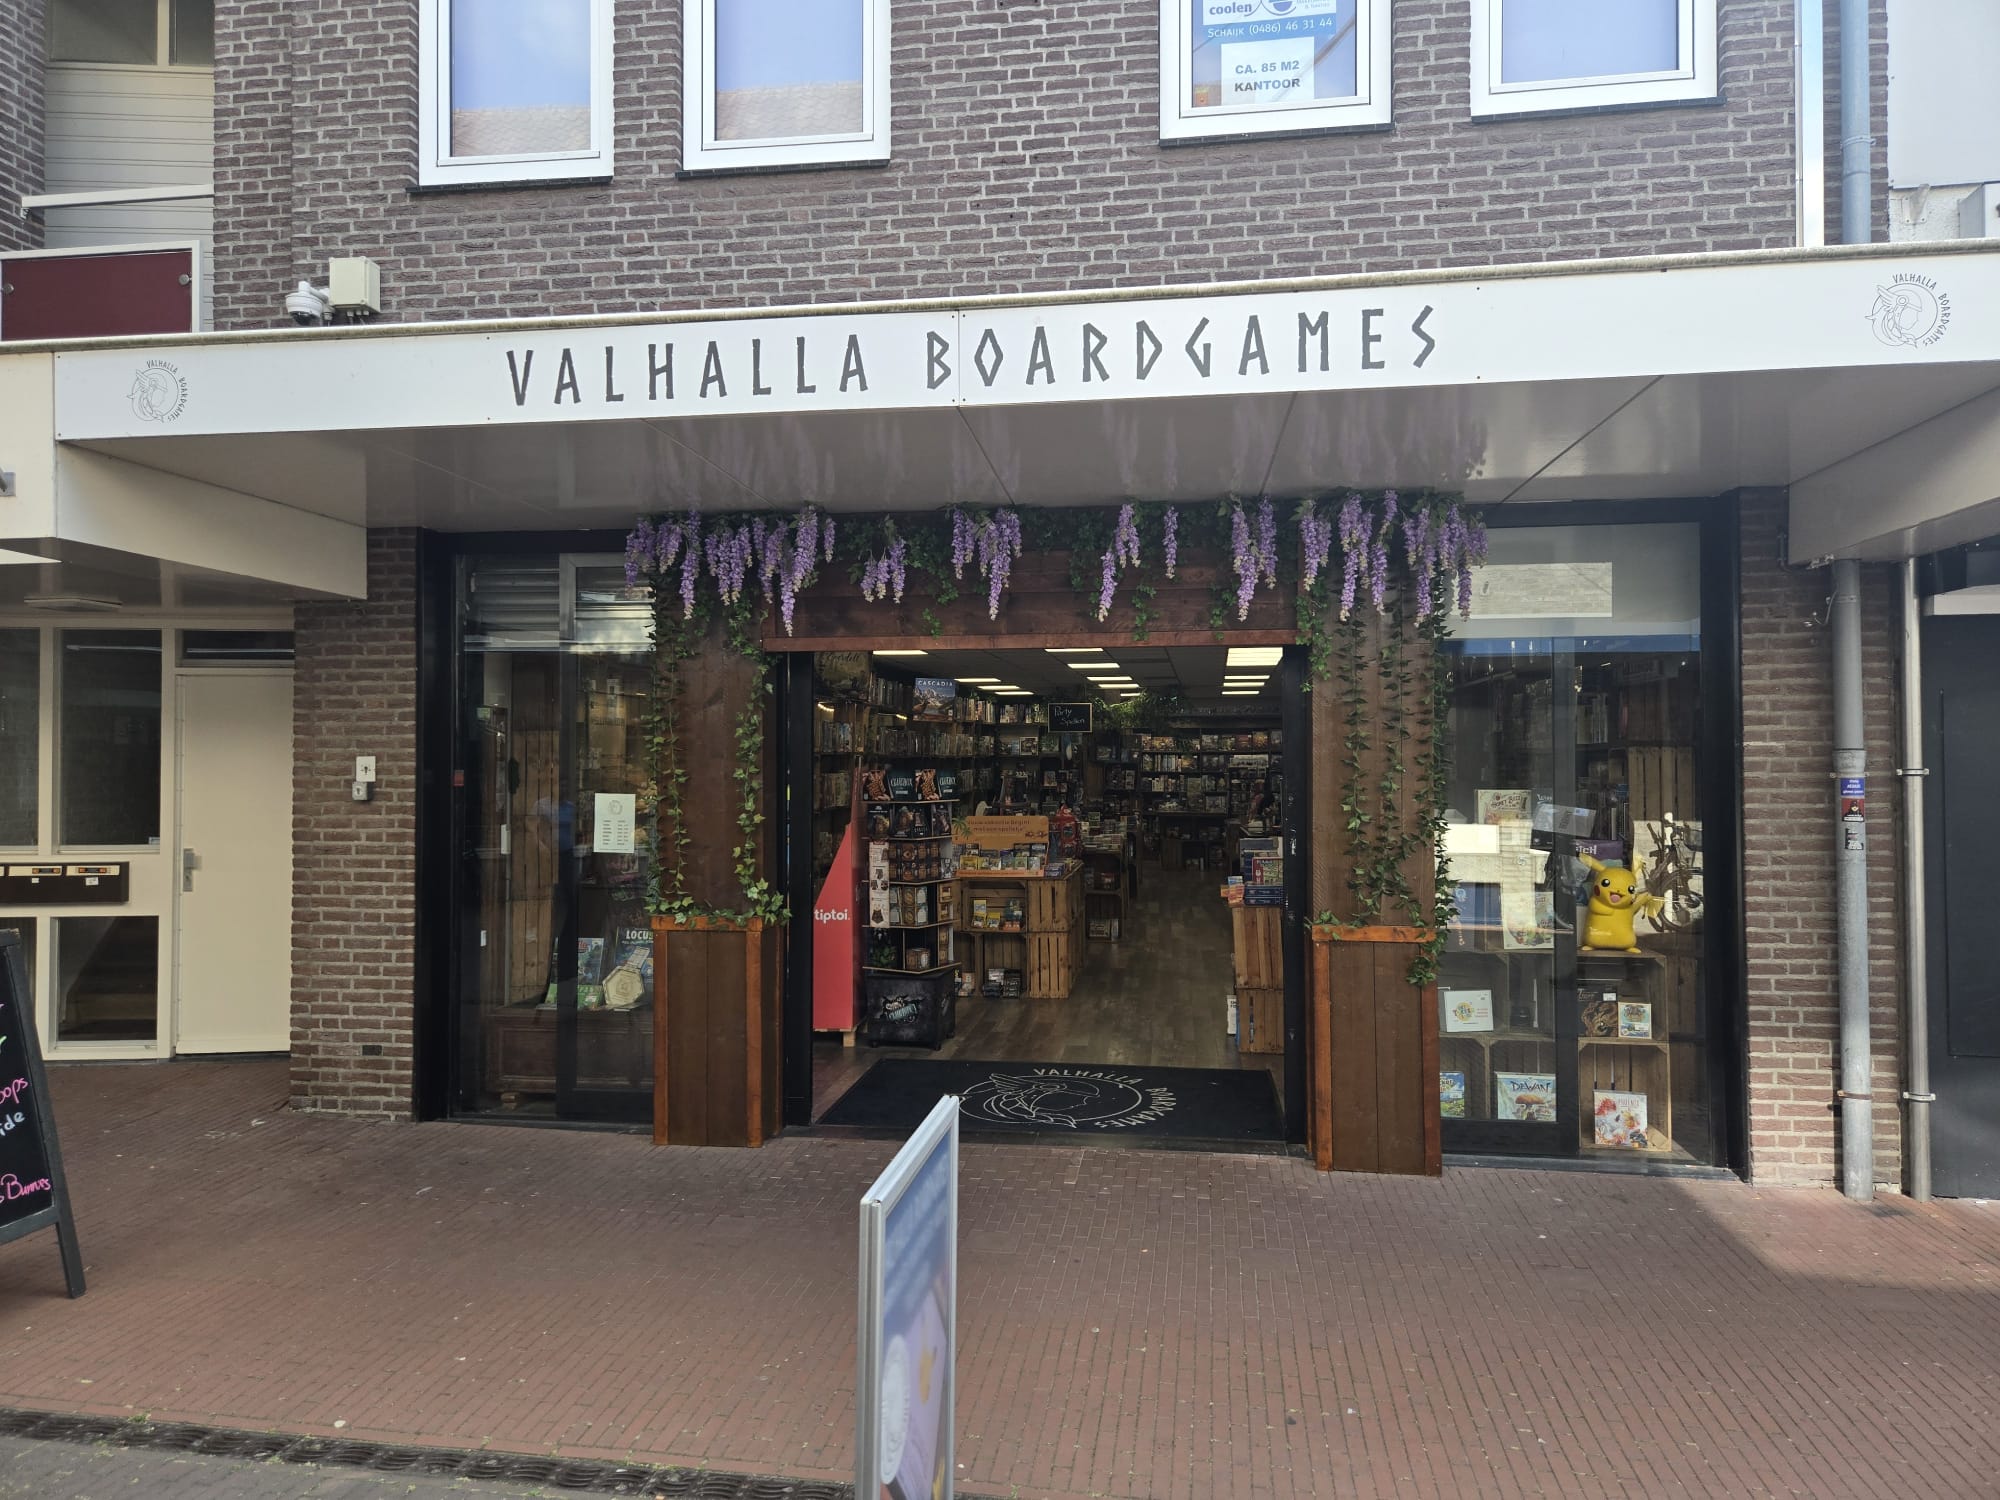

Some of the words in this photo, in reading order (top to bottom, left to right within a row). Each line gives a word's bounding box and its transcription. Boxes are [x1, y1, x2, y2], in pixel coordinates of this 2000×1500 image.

[1209, 2, 1252, 15] coolen
[1249, 23, 1281, 36] (0486)
[1285, 20, 1298, 31] 46
[1303, 19, 1315, 30] 31
[1319, 17, 1333, 28] 44
[1235, 64, 1257, 75] CA.
[1261, 62, 1277, 72] 85
[1280, 60, 1300, 71] M2
[1234, 78, 1301, 92] KANTOOR
[1892, 272, 1937, 291] VALHALLA
[1922, 292, 1952, 347] BOARDGAMES
[506, 334, 869, 406] VALHALLA
[927, 305, 1436, 389] BOARDGAMES
[146, 359, 178, 375] VALHALLA
[1033, 1068, 1143, 1085] VALHALLA
[1510, 1080, 1550, 1094] DEWAN
